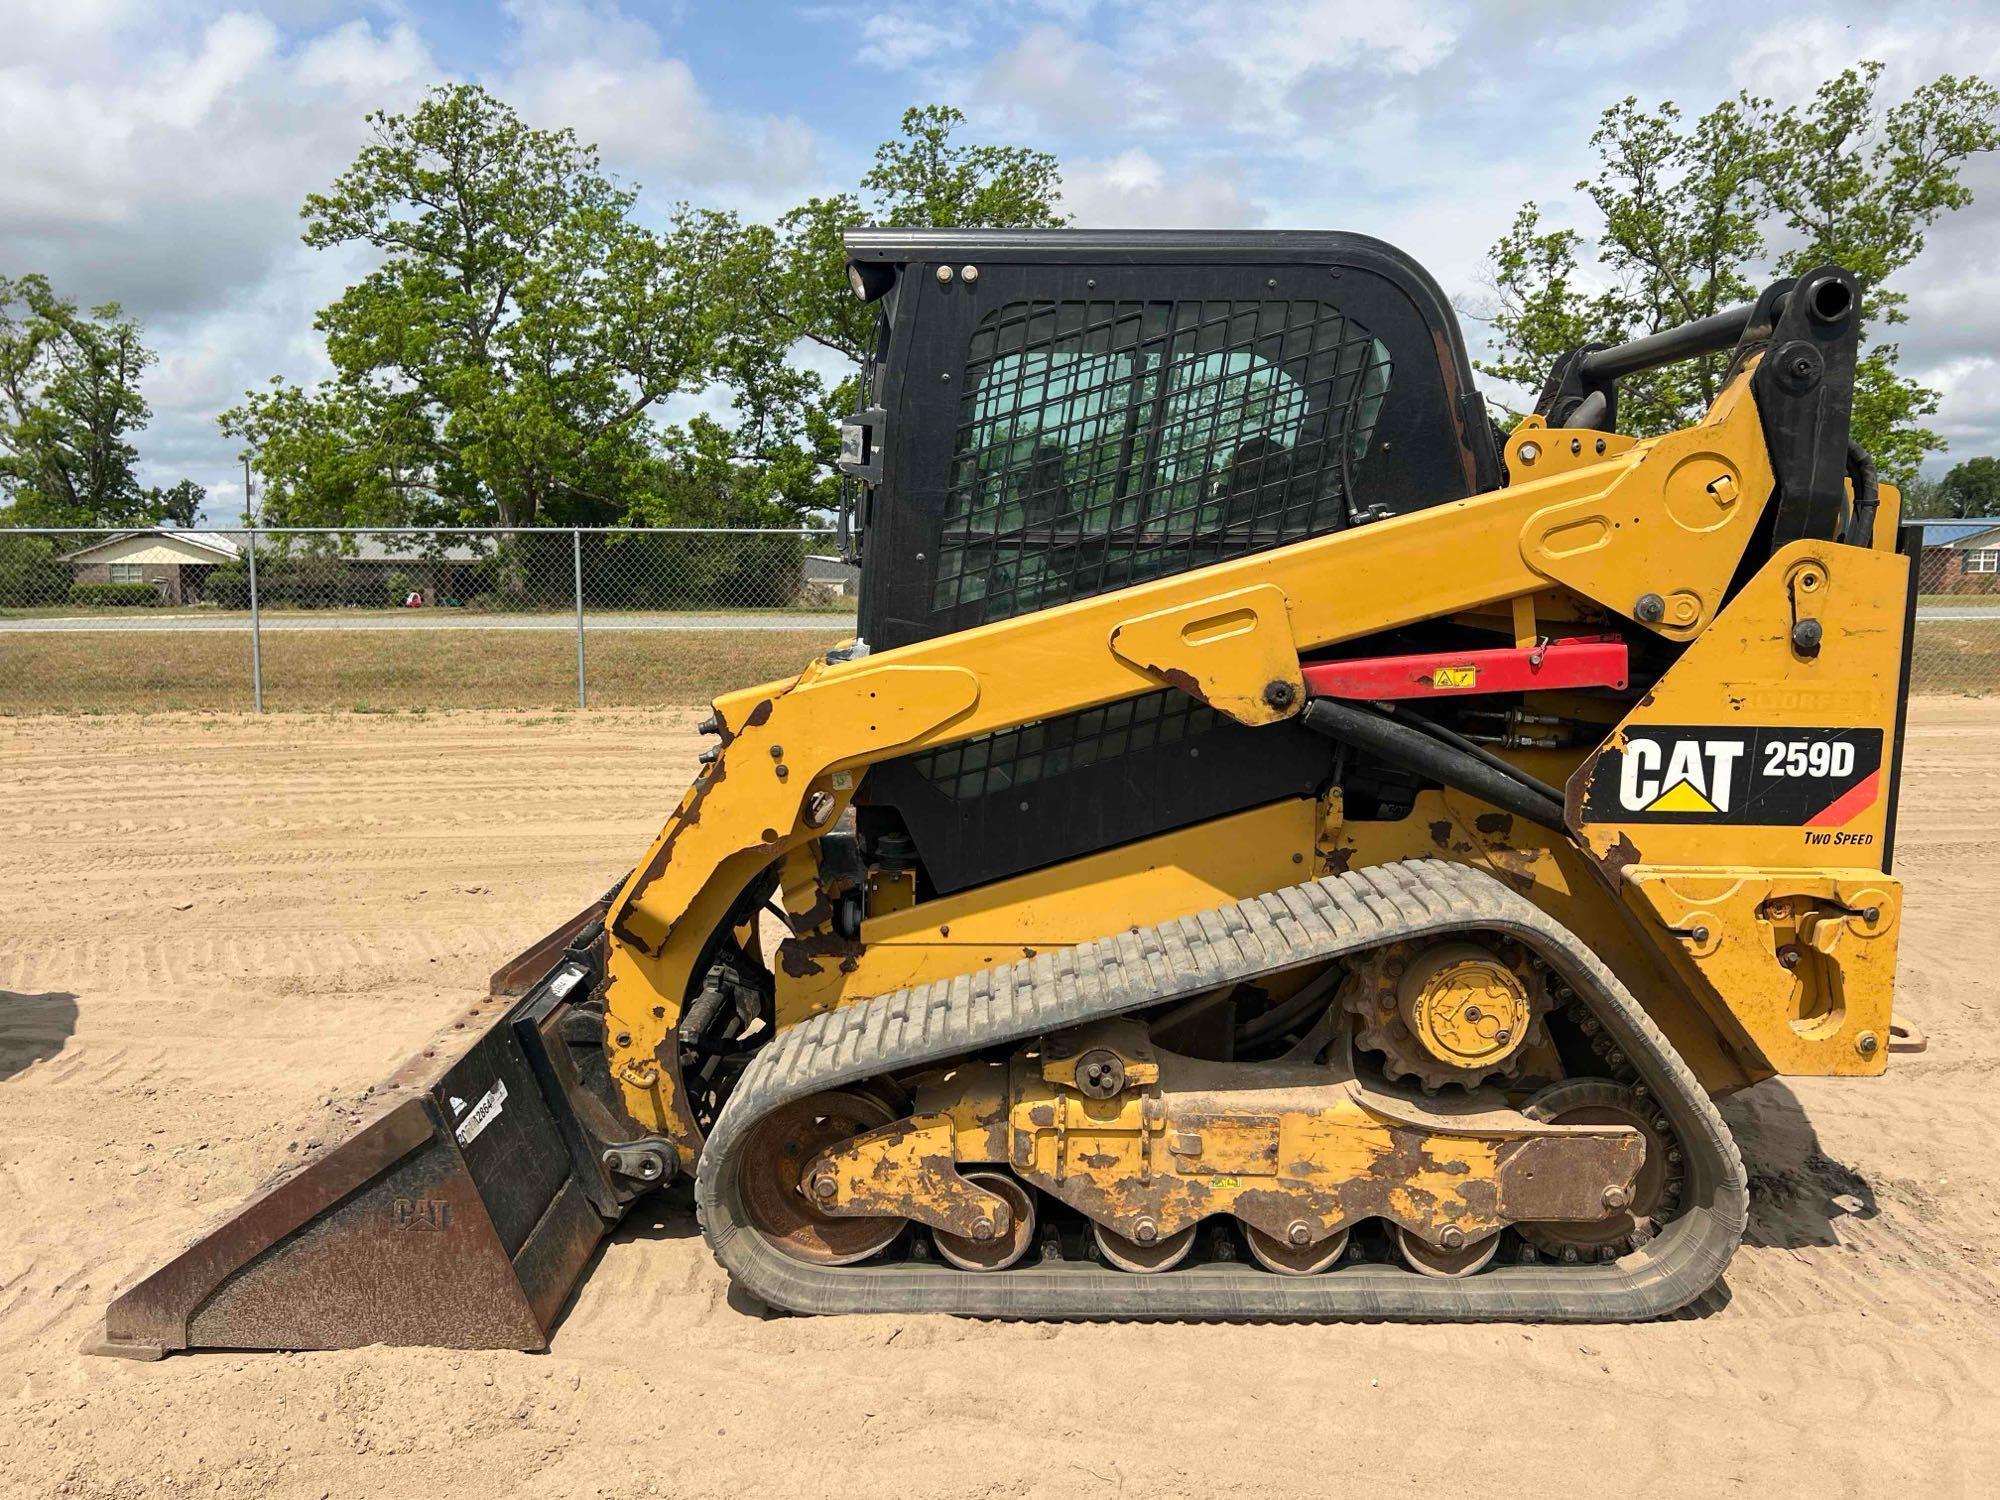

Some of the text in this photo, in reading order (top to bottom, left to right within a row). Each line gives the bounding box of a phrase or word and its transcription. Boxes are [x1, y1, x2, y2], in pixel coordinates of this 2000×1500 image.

[1619, 738, 1855, 812] CAT 259D
[393, 1199, 448, 1231] CAT
